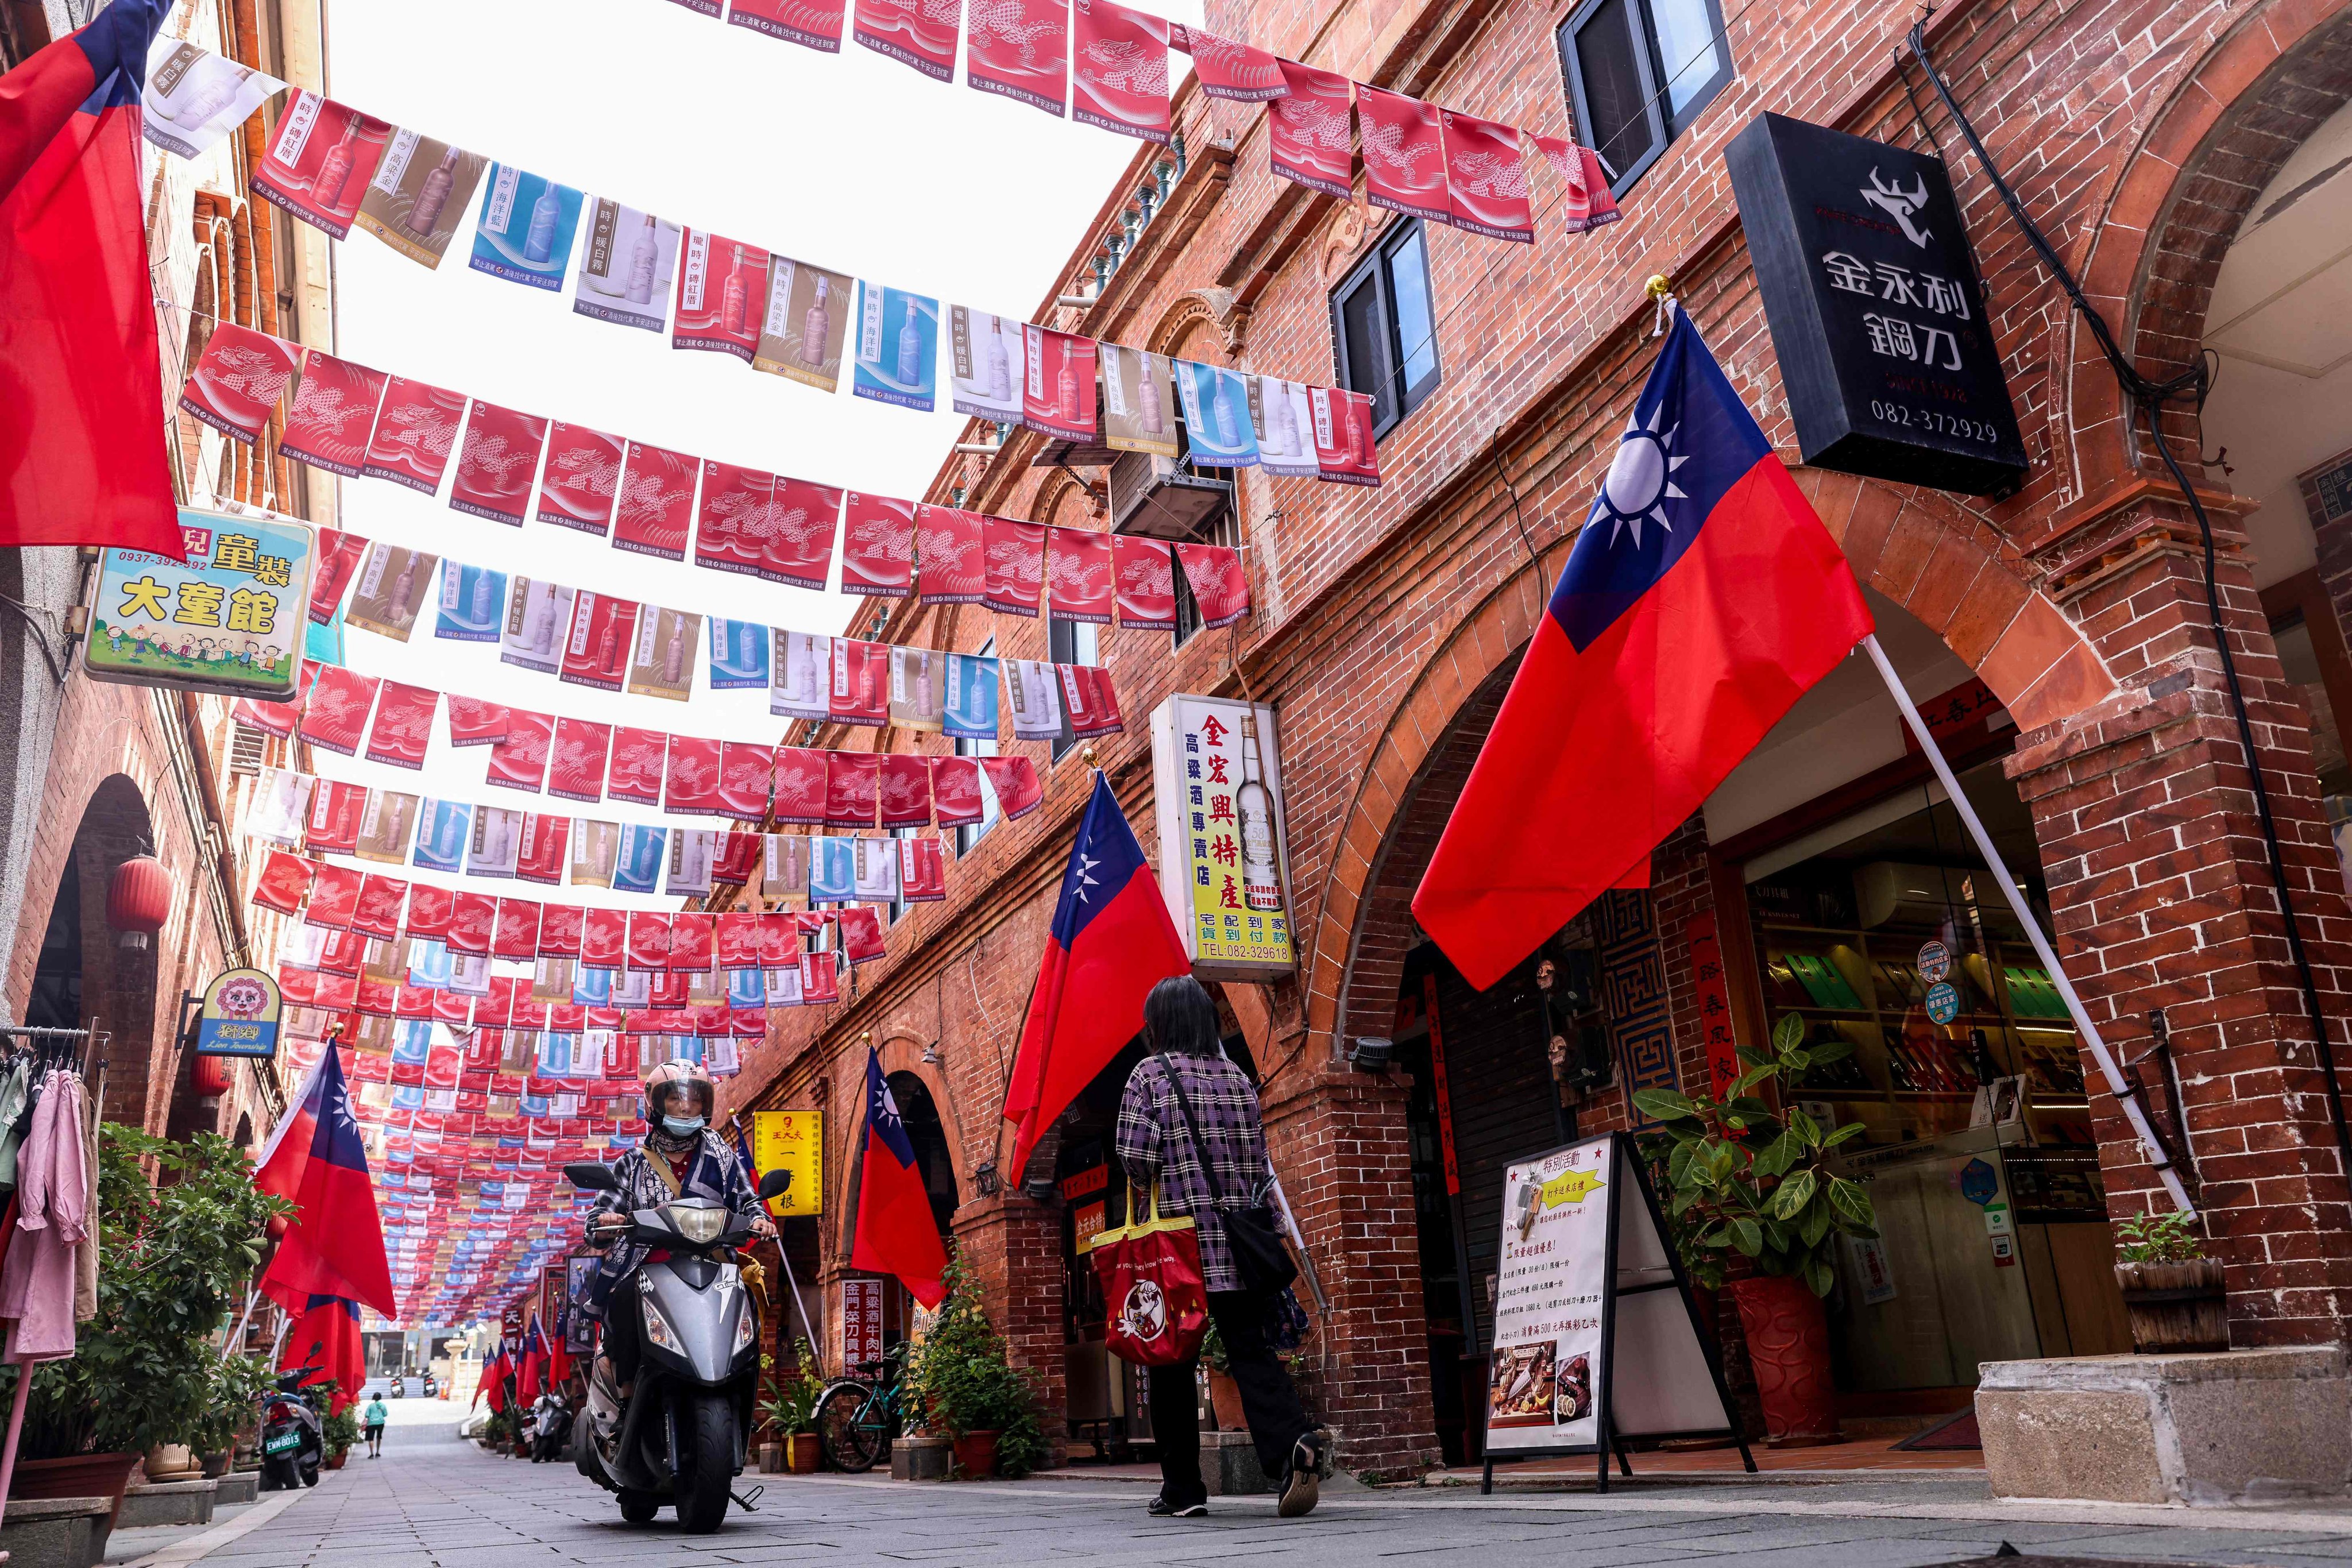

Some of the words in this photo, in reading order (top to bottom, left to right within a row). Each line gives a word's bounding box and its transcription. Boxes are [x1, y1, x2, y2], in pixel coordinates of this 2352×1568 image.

[733, 14, 760, 27] 禁止酒駕
[770, 24, 802, 41] 酒後找代駕
[803, 34, 835, 49] 平安送到家
[857, 33, 880, 50] 禁止酒駕
[890, 47, 918, 66] 酒後找代駕
[920, 60, 949, 78] 平安送到家
[155, 58, 185, 89] 暖白霧
[972, 76, 996, 91] 禁止酒駕
[1005, 86, 1033, 103] 酒後找代駕
[1034, 96, 1061, 114] 平安送到家
[279, 125, 303, 160] 磚紅厝
[1077, 111, 1100, 125] 禁止酒駕
[1109, 121, 1137, 136] 酒後找代駕
[1138, 128, 1166, 142] 平安送到家
[379, 152, 402, 186] 高粱金
[1275, 165, 1295, 179] 禁止酒駕
[1301, 175, 1326, 190] 酒後找代駕
[1327, 183, 1349, 197] 平安送到家
[255, 181, 278, 202] 禁止酒駕
[285, 201, 314, 221] 酒後找代駕
[315, 217, 343, 237] 平安送到家
[490, 192, 508, 227] 海洋藍
[1371, 196, 1391, 206] 禁止酒駕
[1399, 203, 1423, 216] 酒後找代駕
[1423, 210, 1448, 222] 平安送到家
[1456, 219, 1475, 231] 禁止酒駕
[1482, 225, 1505, 237] 酒後找代駕
[1506, 230, 1531, 241] 平安送到家
[592, 236, 607, 271] 暖白霧
[1822, 250, 1971, 320] 金永利
[1863, 312, 1963, 371] 鋼刀
[1318, 418, 1328, 445] 磚紅厝
[1871, 399, 1998, 443] 082-372929
[211, 533, 292, 587] 童裝
[118, 576, 278, 634] 大童館
[1185, 733, 1210, 886] 高粱酒專賣店
[1200, 715, 1243, 909] 金宏興特產
[1251, 897, 1277, 907] 酒後不開車
[1200, 913, 1286, 930] 宅配到家
[1201, 927, 1288, 943] 貨到付款
[1202, 943, 1288, 959] TEL:082-329618
[1929, 995, 1956, 1009] 優惠店家
[206, 1040, 227, 1049] Lion
[230, 1041, 267, 1052] Township
[215, 1022, 260, 1041] 獅鄉
[773, 1130, 804, 1140] 王大夫
[1544, 1150, 1580, 1174] 特別活動
[1547, 1180, 1585, 1198] 打卡送來店禮
[845, 1283, 860, 1365] 金門菜刀貢糖
